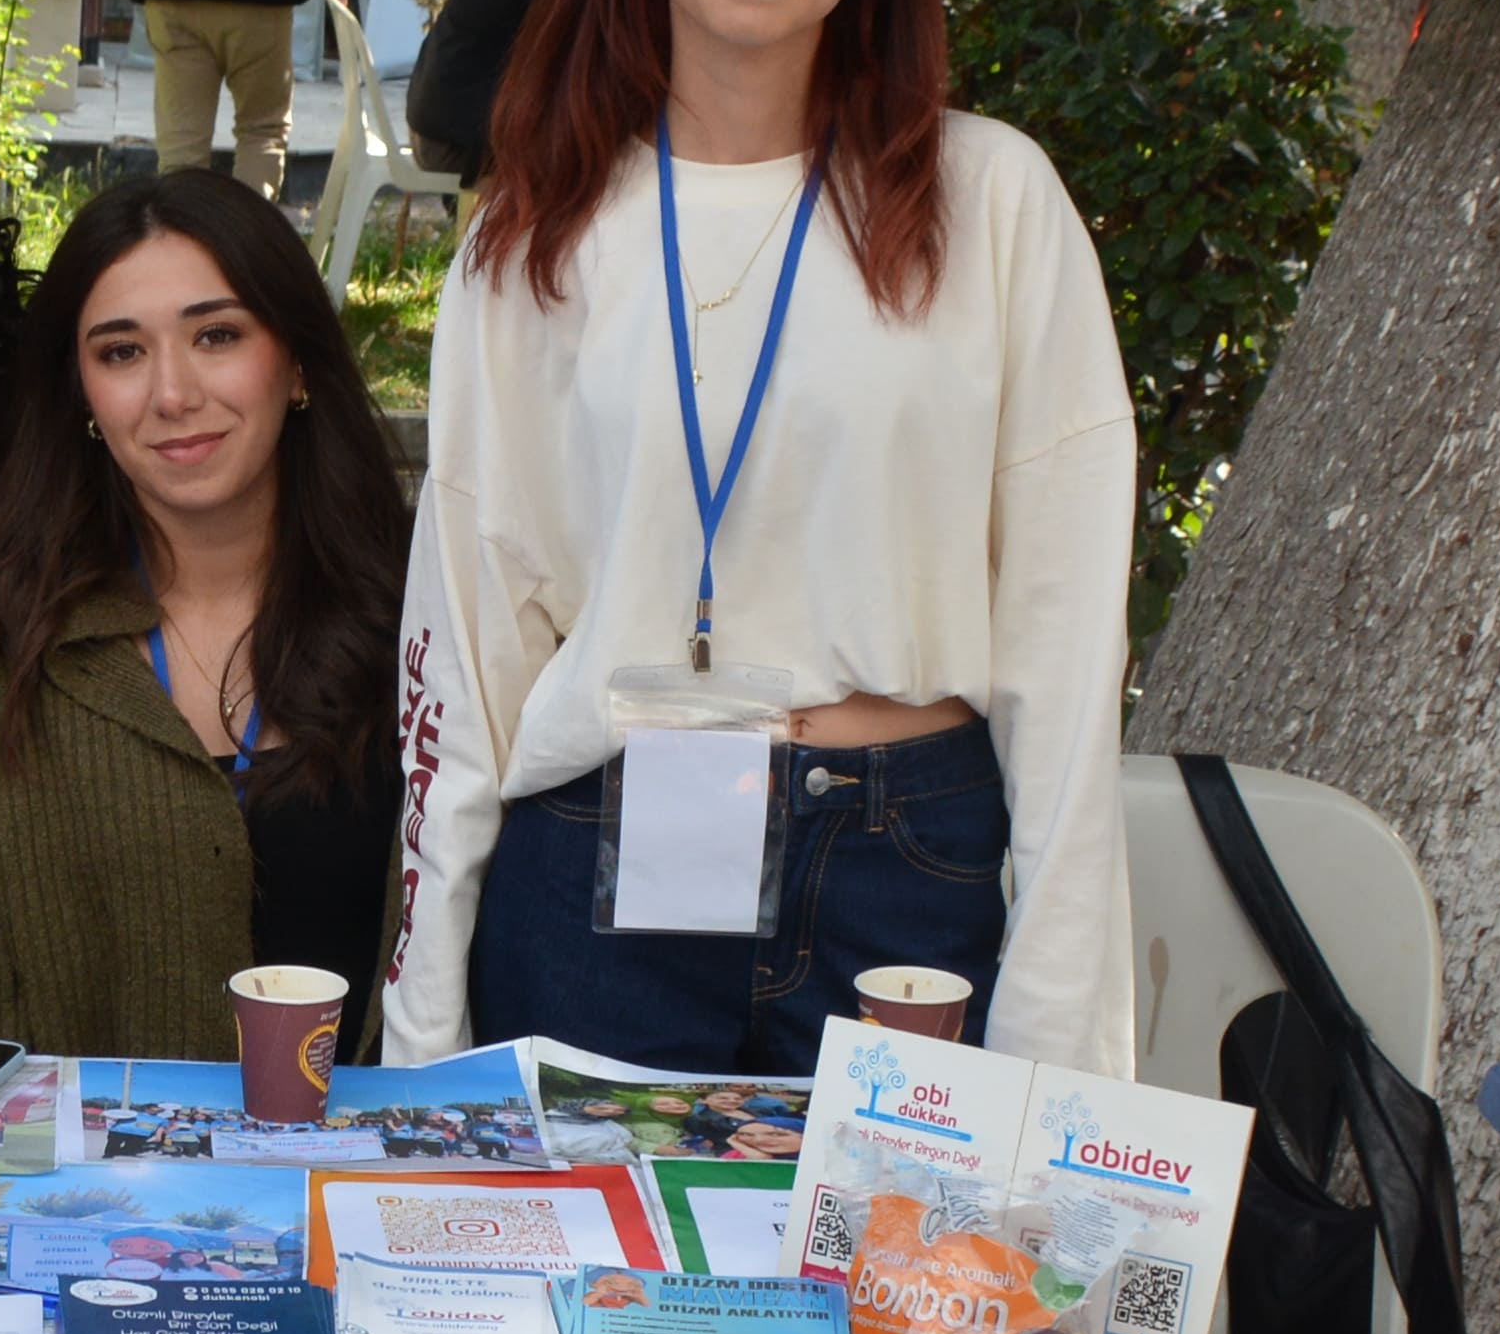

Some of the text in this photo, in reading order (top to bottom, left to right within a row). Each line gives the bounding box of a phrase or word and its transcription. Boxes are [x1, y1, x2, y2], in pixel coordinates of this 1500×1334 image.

[913, 1082, 951, 1107] obi
[897, 1100, 958, 1128] dükkan
[1079, 1140, 1193, 1184] obidev
[661, 1275, 740, 1290] OTİZM
[111, 1309, 234, 1322] Otizmli Bireyler
[410, 1309, 505, 1321] obidev
[658, 1302, 830, 1321] OTİZMİ ANLATIYOR
[167, 1320, 192, 1330] Bir
[235, 1320, 279, 1333] Değil
